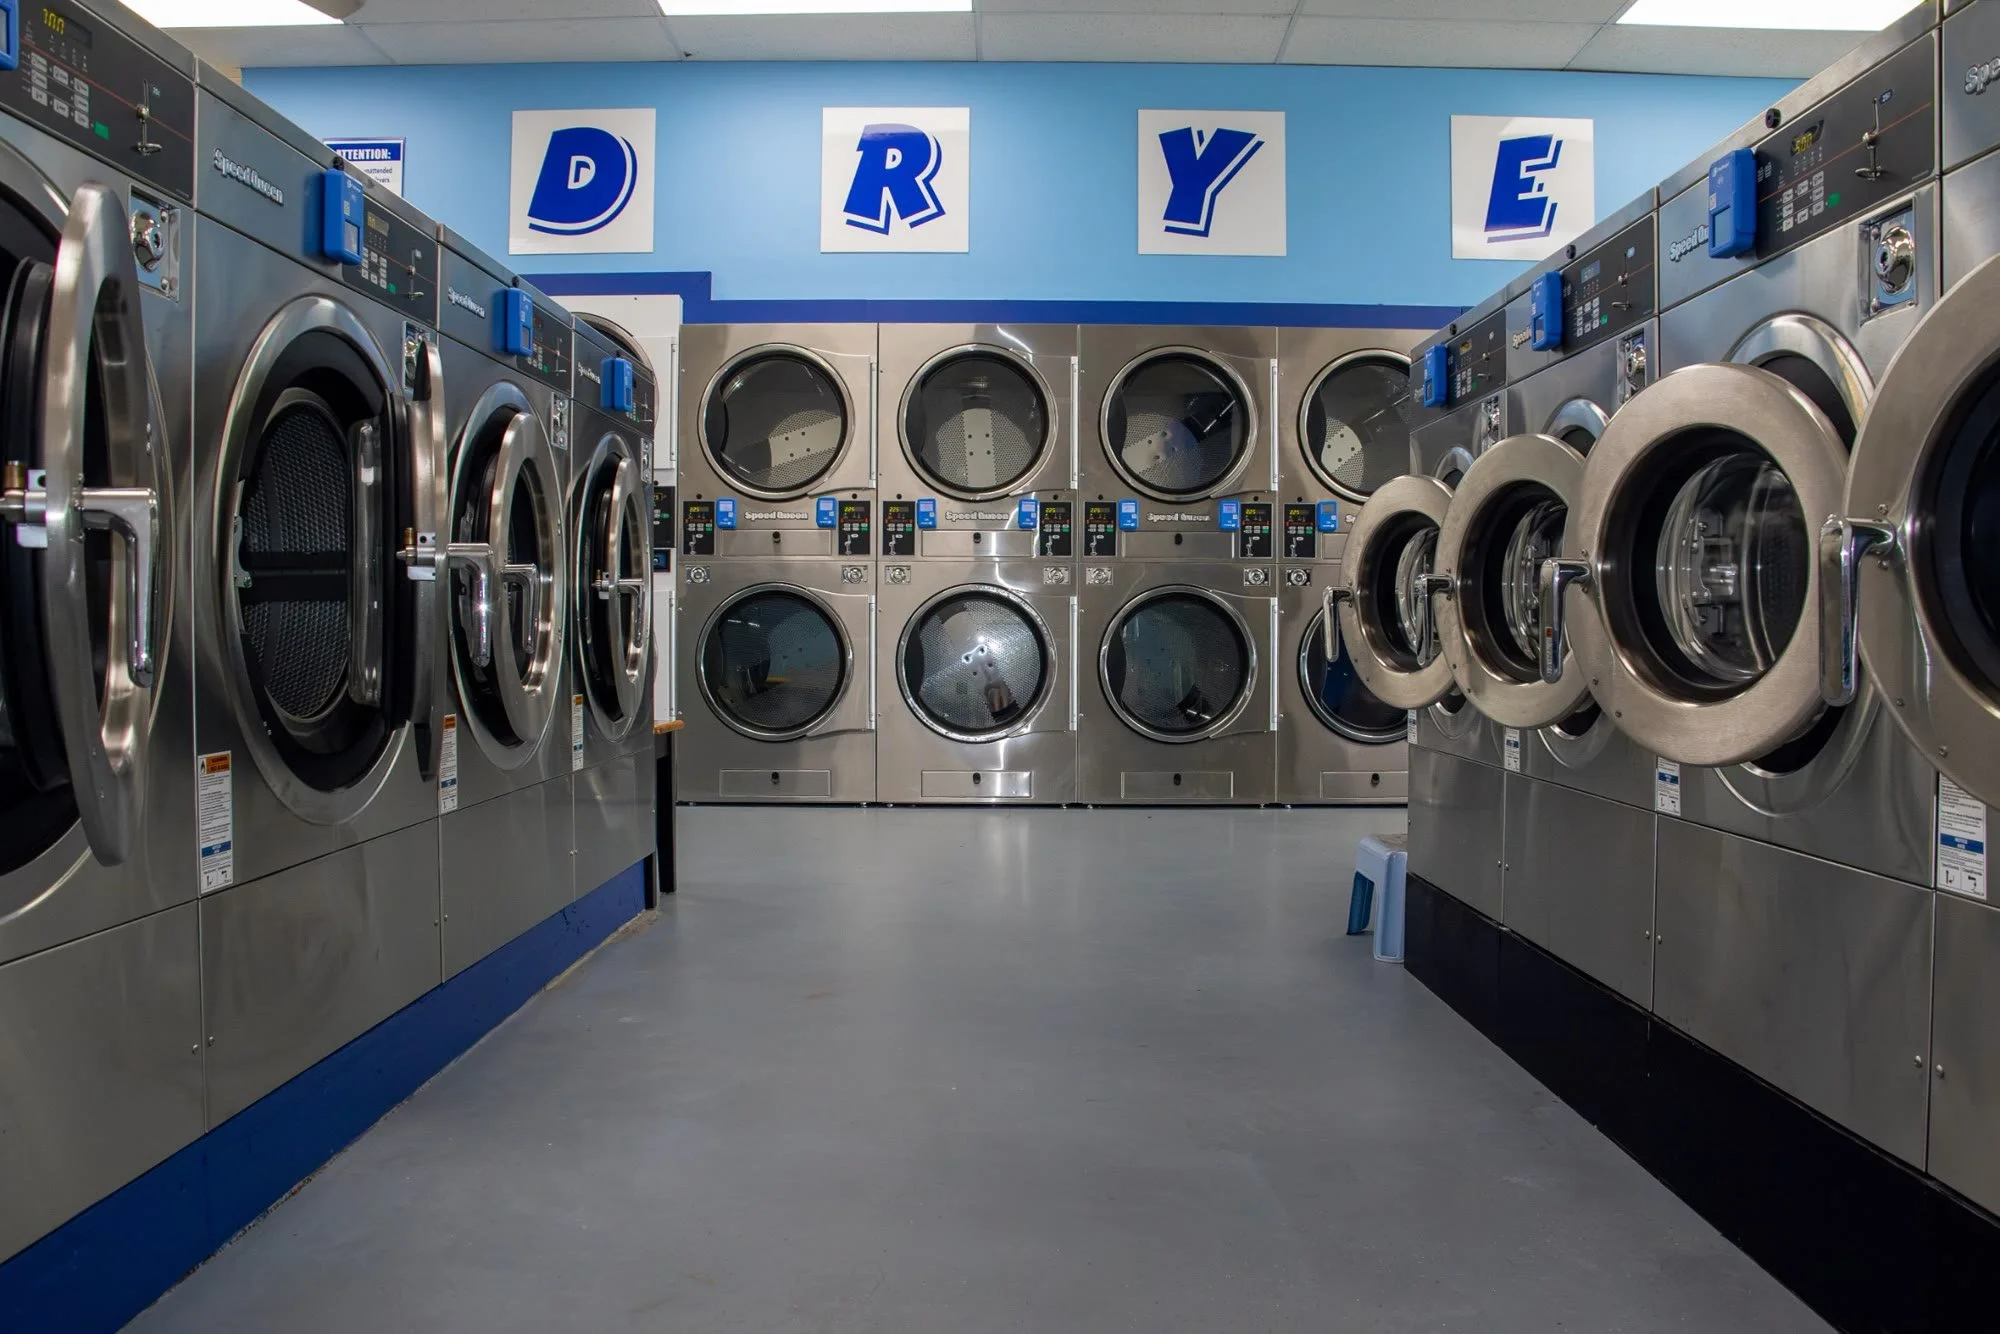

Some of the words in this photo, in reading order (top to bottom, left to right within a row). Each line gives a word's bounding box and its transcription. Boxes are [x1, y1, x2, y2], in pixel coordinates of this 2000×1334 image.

[214, 148, 251, 187] Speed
[250, 169, 284, 206] Queen
[527, 126, 638, 236] D
[842, 122, 946, 236] R
[1158, 126, 1265, 238] Y
[1483, 133, 1564, 244] E
[744, 511, 777, 522] Speed
[777, 511, 808, 520] Queen
[945, 511, 977, 522] Speed
[978, 511, 1009, 521] Queen
[1147, 512, 1179, 522] Speed
[1180, 512, 1210, 521] Queen
